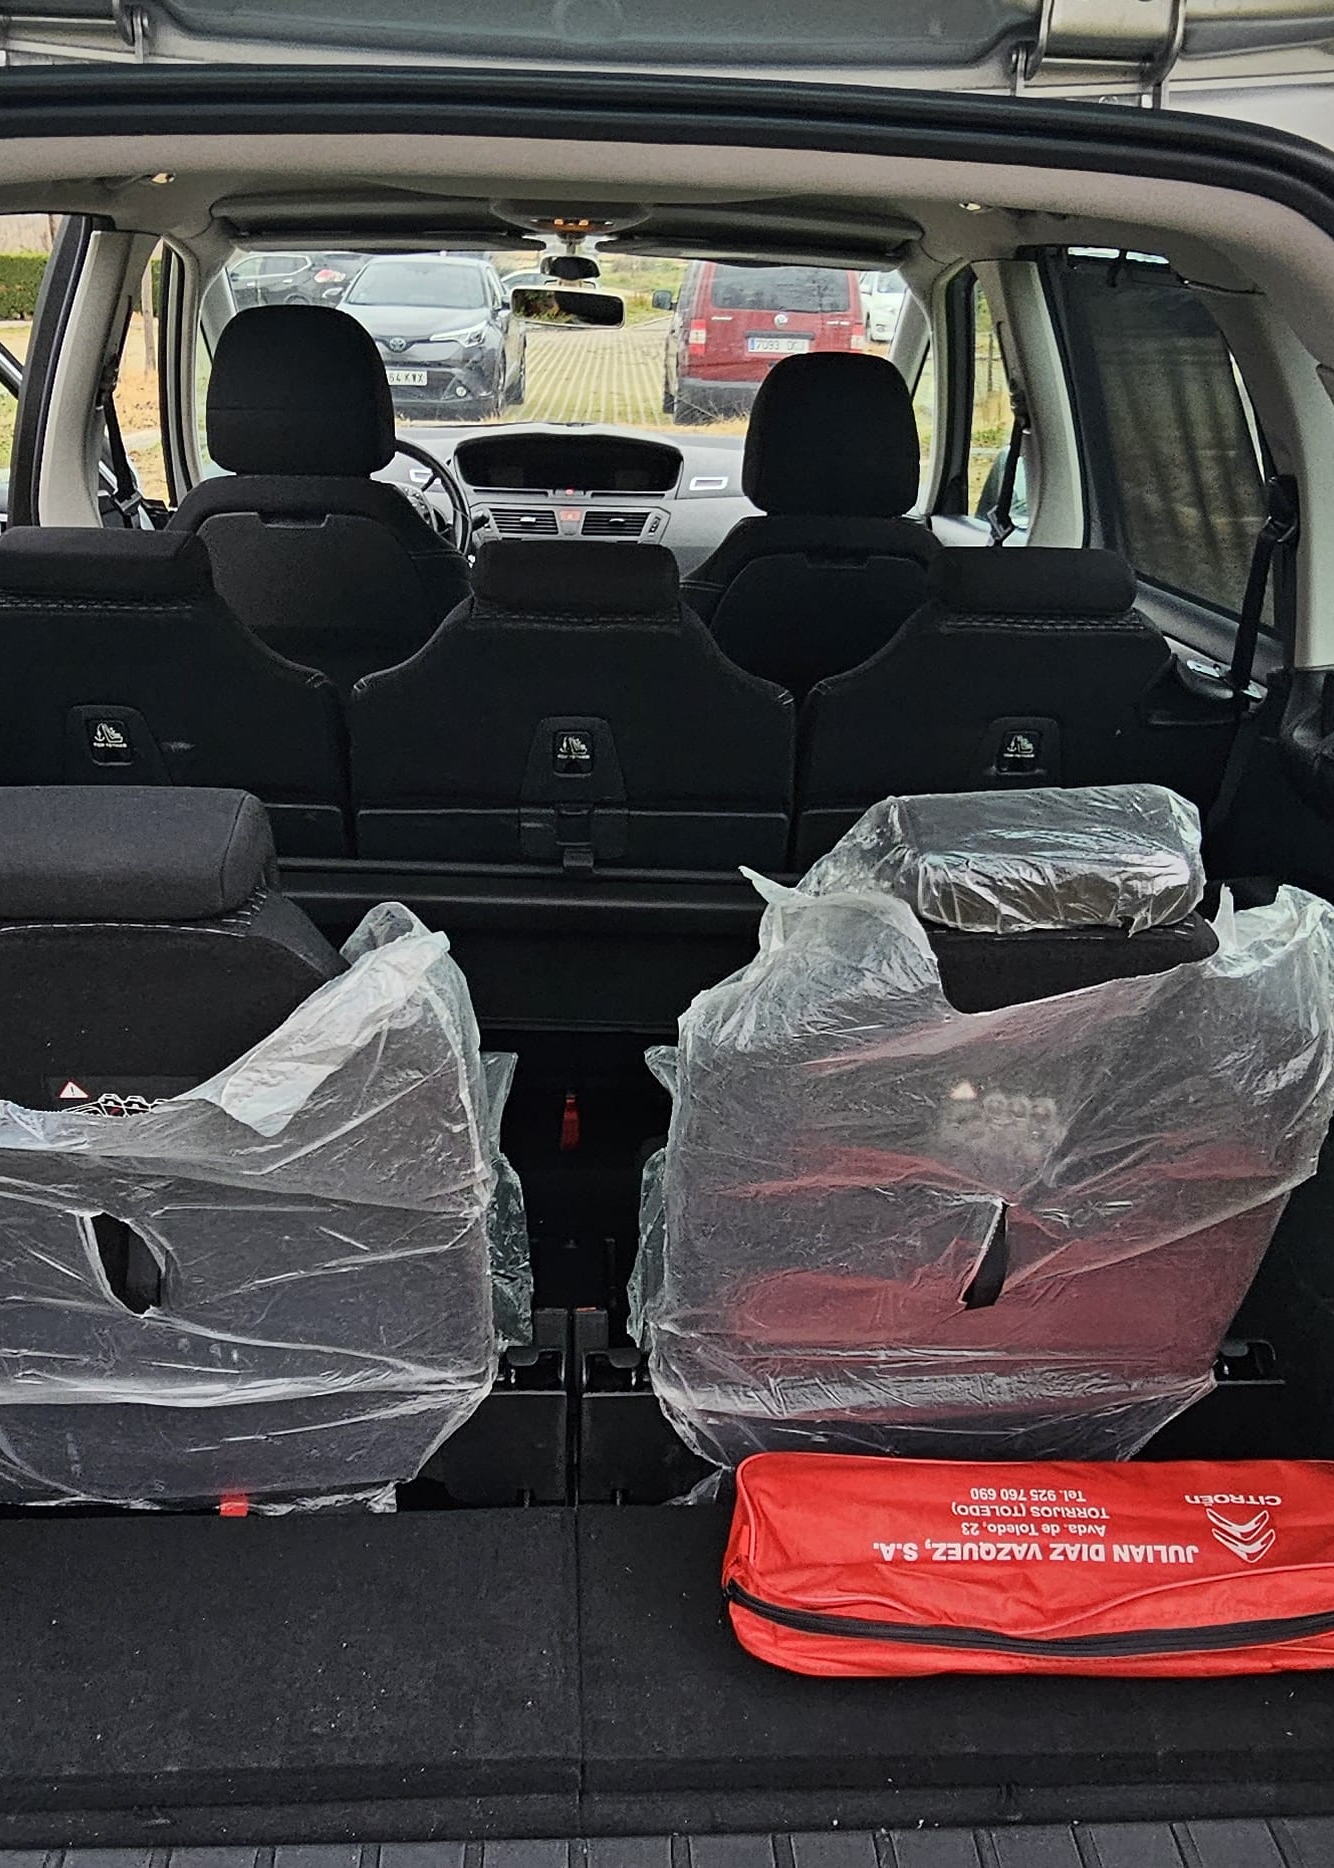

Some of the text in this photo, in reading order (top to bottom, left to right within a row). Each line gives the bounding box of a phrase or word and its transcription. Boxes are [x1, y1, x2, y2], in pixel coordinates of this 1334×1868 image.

[970, 1487, 1087, 1503] Tel. 925 760 690
[951, 1502, 1110, 1519] TORRIJOS (TOLEDO)
[960, 1521, 1106, 1538] Avda. de Toledo, 23
[873, 1538, 1200, 1564] JULIAN DIAZ VAZQUEZ, S.A.
